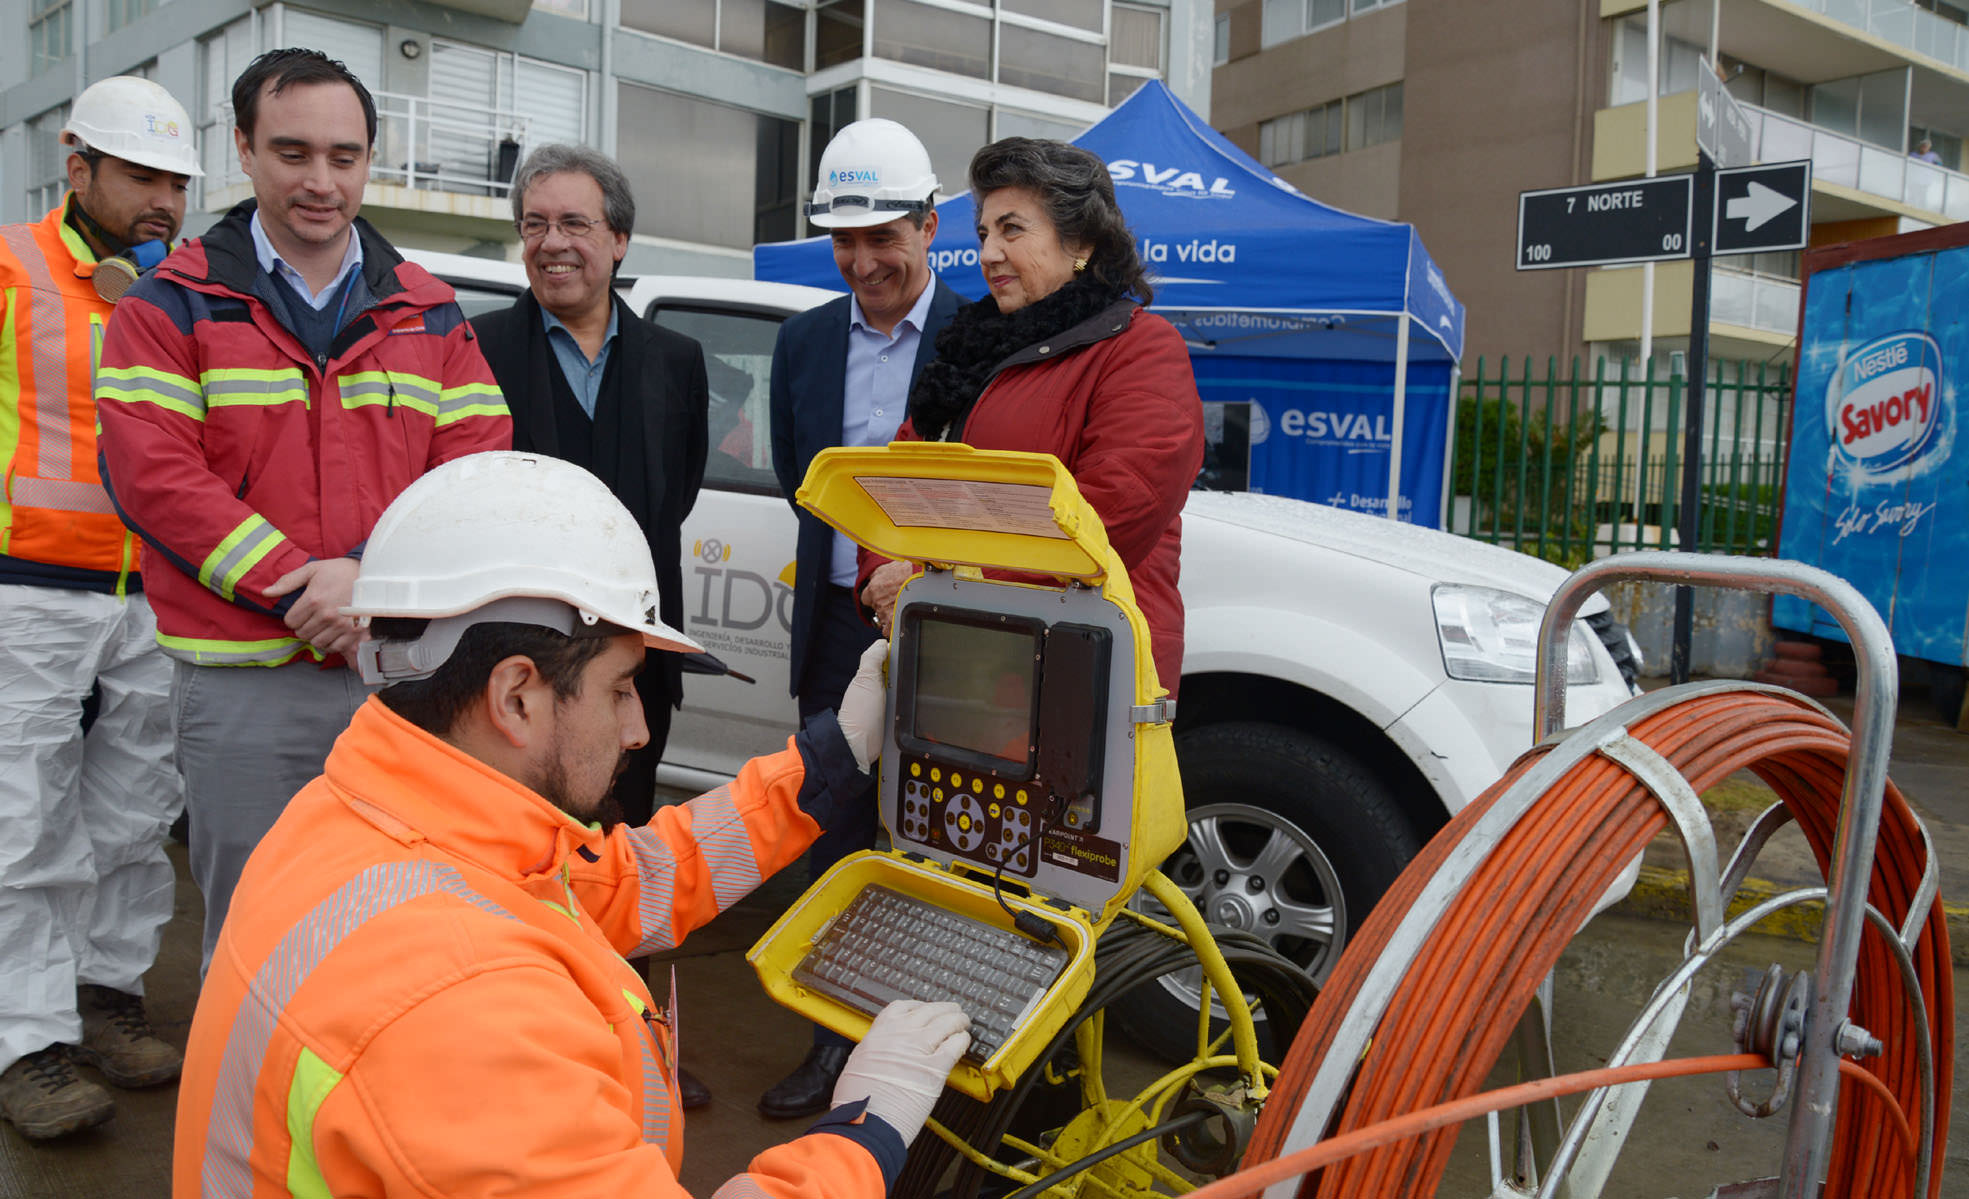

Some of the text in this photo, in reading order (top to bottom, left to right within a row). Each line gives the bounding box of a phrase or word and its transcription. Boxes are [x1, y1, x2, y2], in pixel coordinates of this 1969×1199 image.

[1106, 159, 1236, 195] SVAL
[1566, 190, 1644, 214] 7 NORTE
[1143, 239, 1237, 263] la vida
[1526, 233, 1682, 262] 100 00
[1841, 382, 1931, 446] Savory
[1070, 844, 1118, 867] flexiprobe
